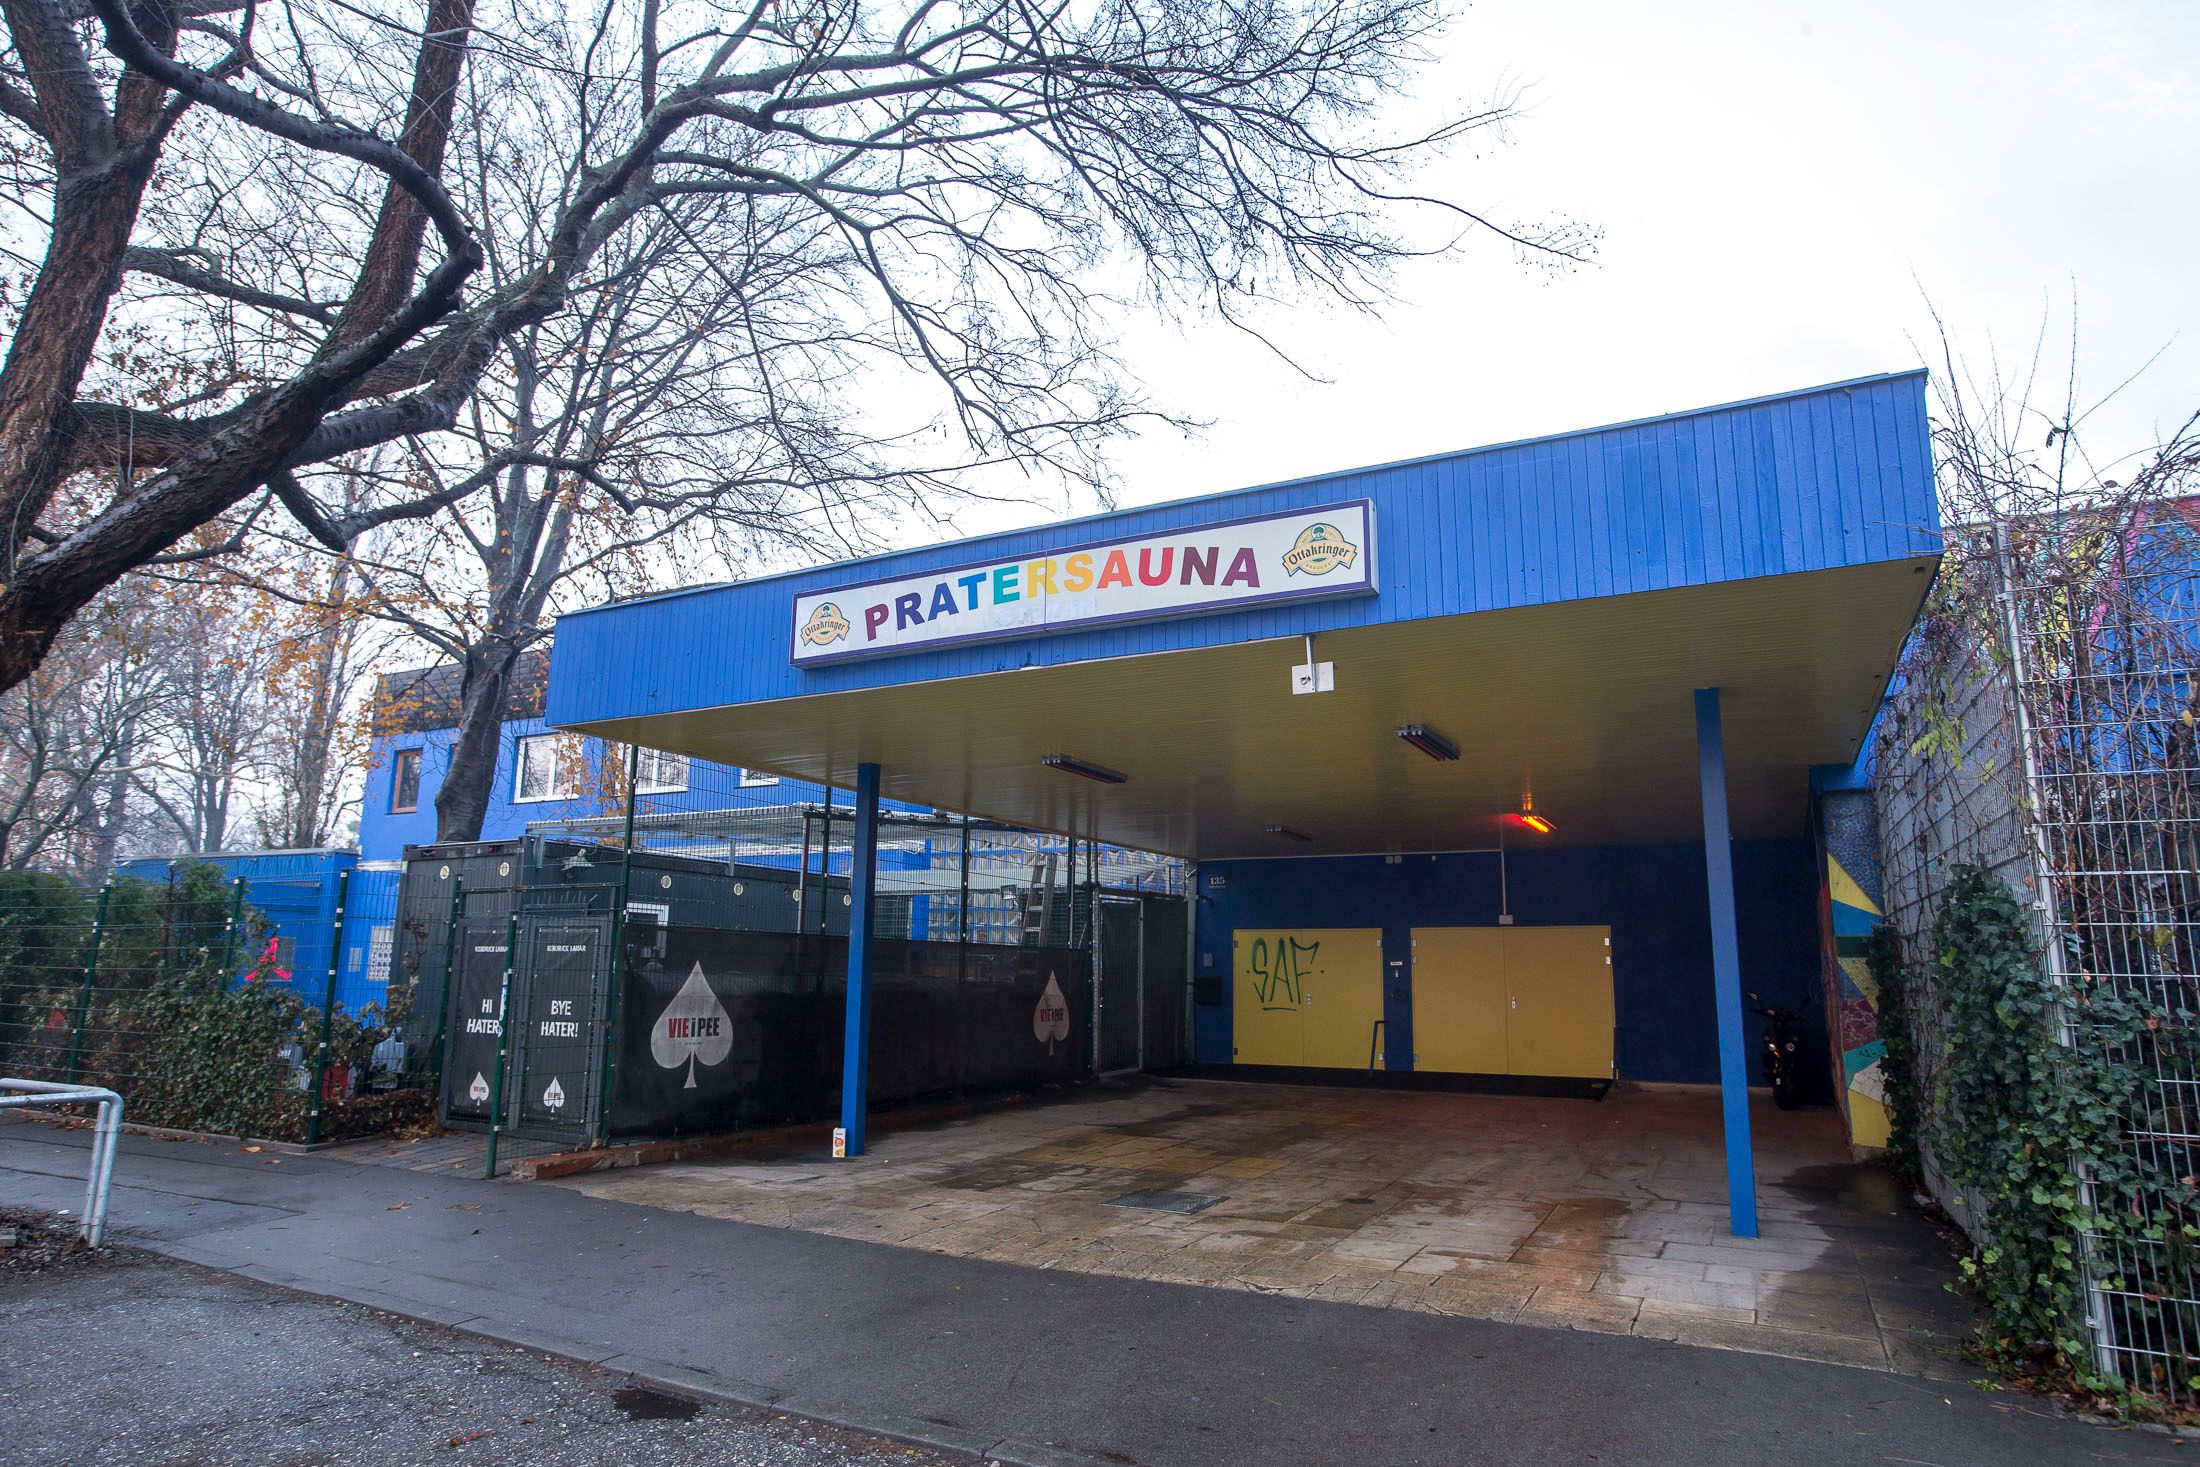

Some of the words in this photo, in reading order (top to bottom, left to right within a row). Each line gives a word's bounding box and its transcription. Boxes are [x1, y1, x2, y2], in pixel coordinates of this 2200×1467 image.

[1288, 542, 1350, 565] Ottakringer
[864, 547, 1260, 642] PRATERSAUNA
[804, 618, 846, 637] Ottakringer
[481, 999, 493, 1013] HI
[550, 1000, 573, 1016] BYE
[540, 1021, 579, 1038] HATER!
